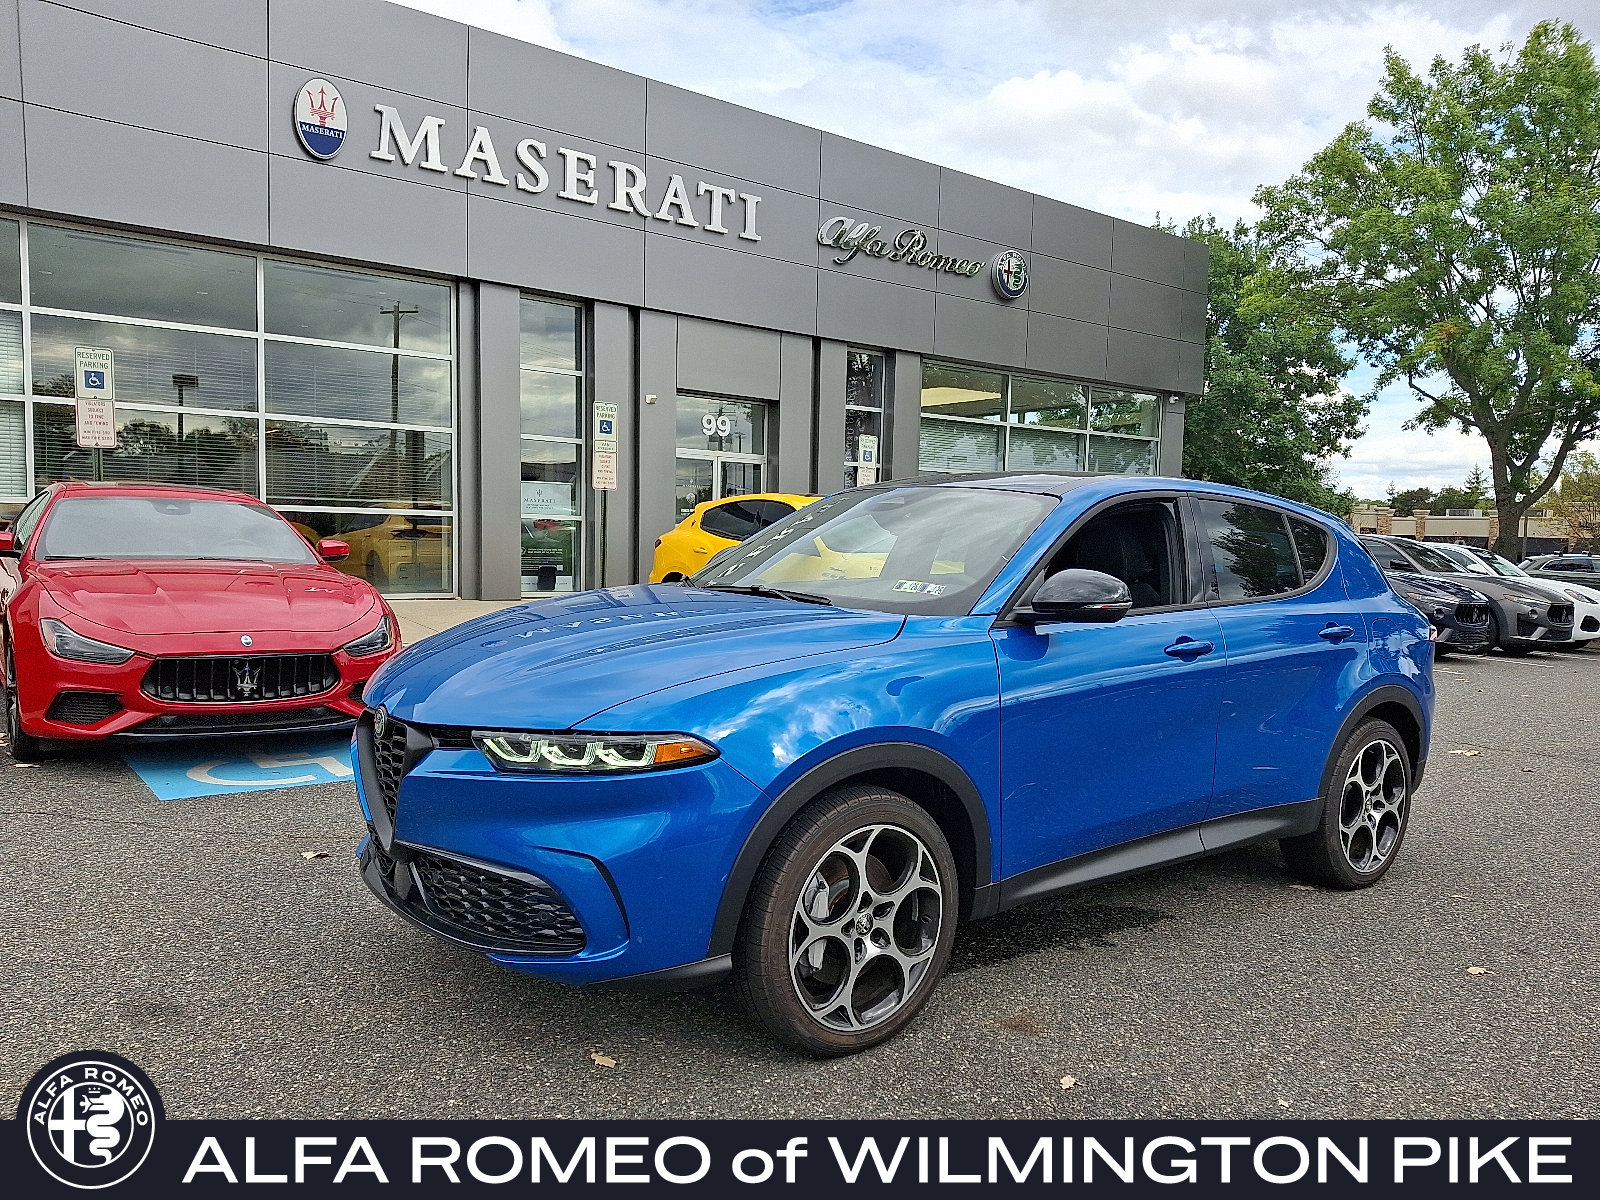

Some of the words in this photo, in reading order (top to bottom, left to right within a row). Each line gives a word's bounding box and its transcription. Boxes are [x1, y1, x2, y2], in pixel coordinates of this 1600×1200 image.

[302, 124, 343, 139] MASERATI
[369, 103, 762, 242] MASERATI
[817, 216, 891, 264] Alfa
[889, 229, 986, 277] Romeo
[77, 352, 110, 361] RESERVED
[79, 361, 109, 369] PARKING
[701, 414, 731, 437] 99
